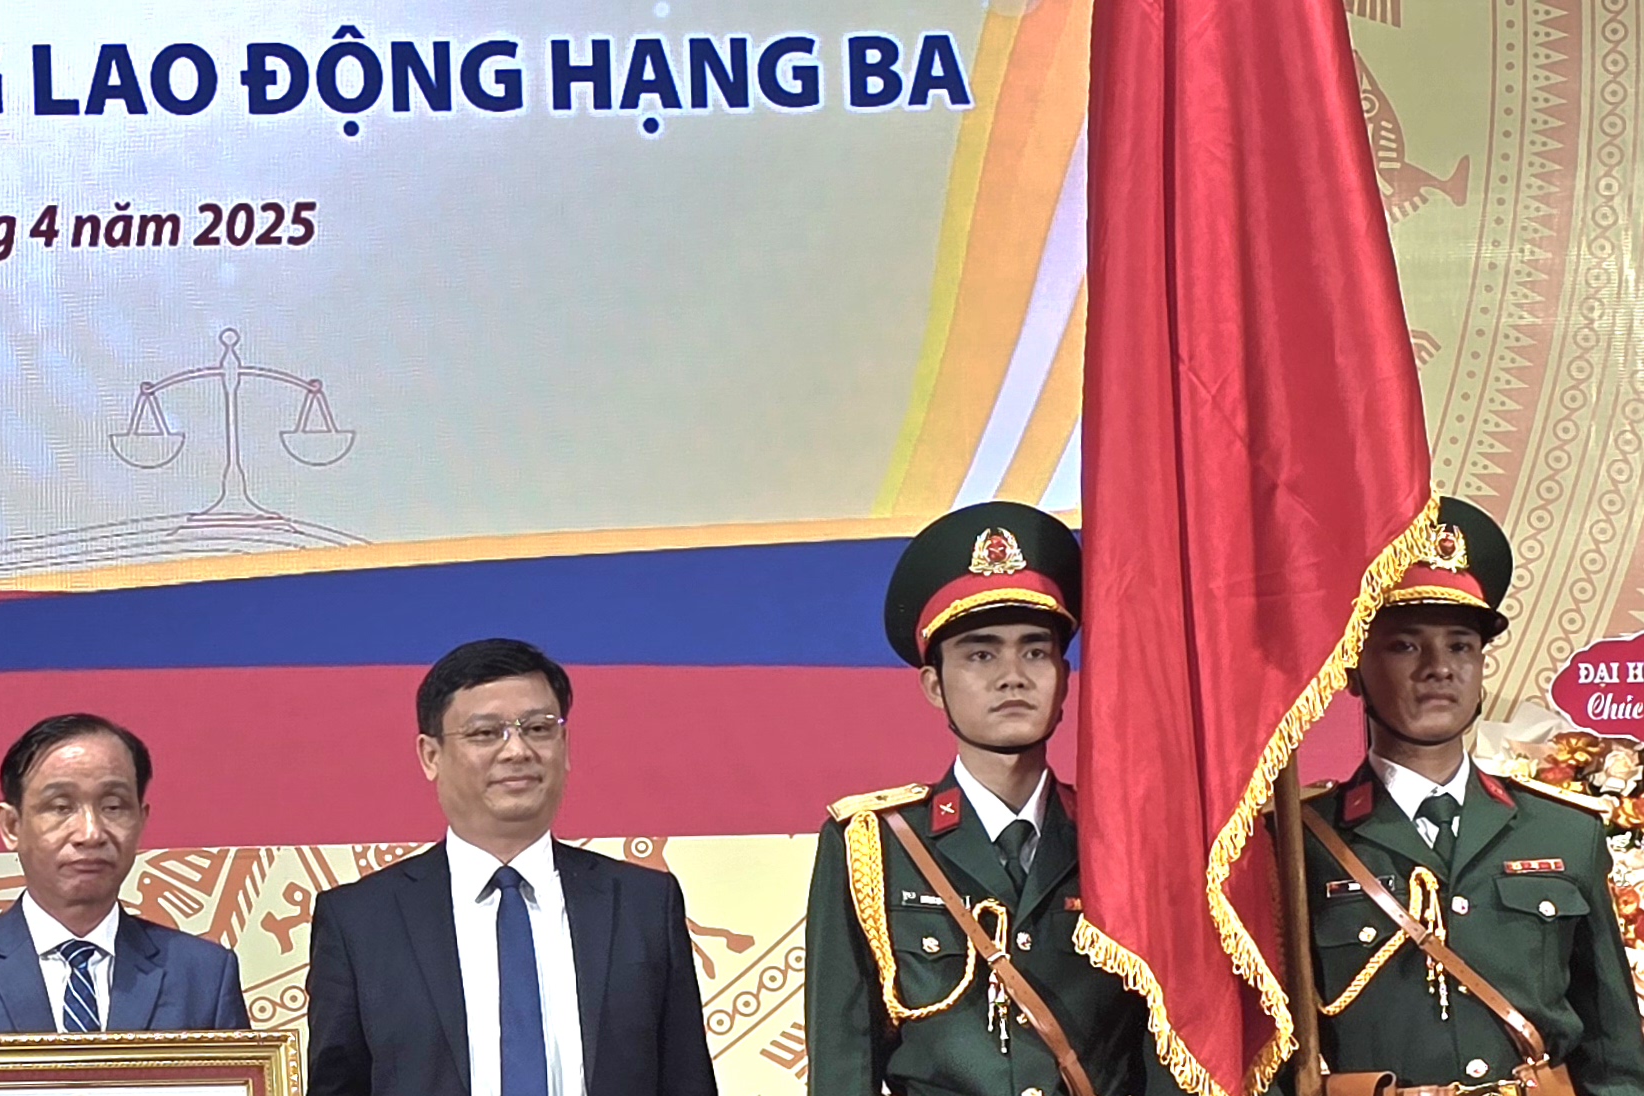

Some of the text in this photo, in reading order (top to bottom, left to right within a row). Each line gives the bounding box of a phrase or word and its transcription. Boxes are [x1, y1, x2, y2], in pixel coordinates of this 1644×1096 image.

[33, 43, 217, 116] LAO
[241, 25, 522, 137] ĐỘNG
[551, 36, 820, 134] HẠNG
[848, 34, 970, 108] BA
[29, 204, 59, 248] 4
[71, 202, 180, 249] năm
[193, 201, 317, 247] 2025
[1578, 662, 1620, 688] ĐẠI
[1587, 692, 1644, 720] Chúc
